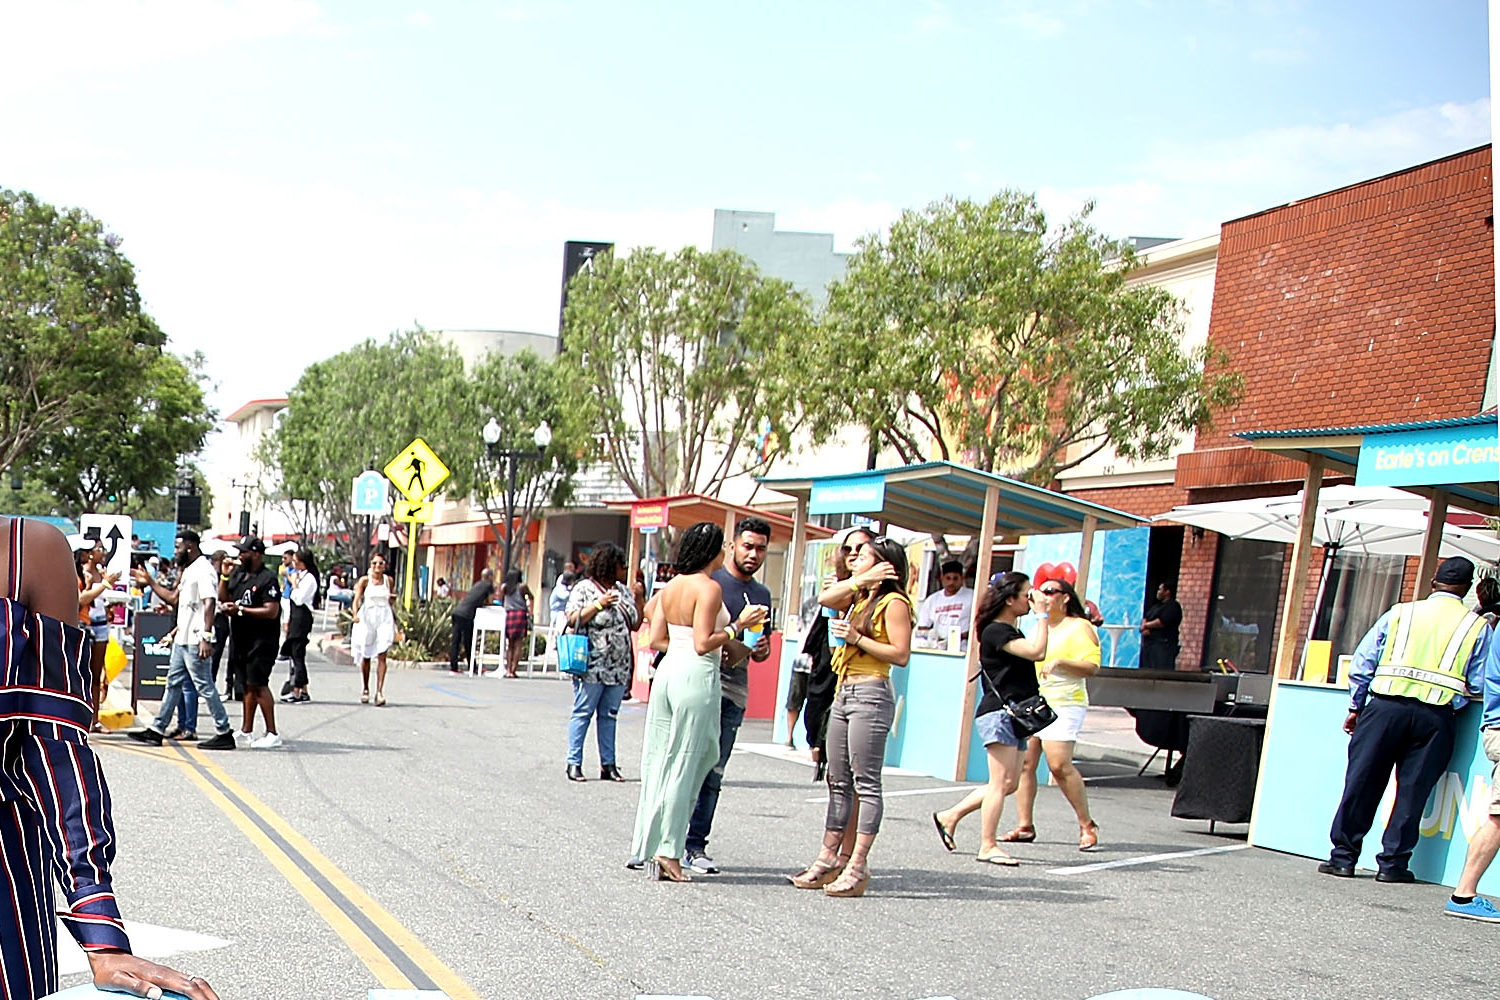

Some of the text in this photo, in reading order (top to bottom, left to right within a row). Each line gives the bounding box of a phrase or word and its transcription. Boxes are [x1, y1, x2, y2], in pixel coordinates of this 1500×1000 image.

[1375, 447, 1425, 471] Earle's
[1427, 449, 1449, 467] on
[364, 487, 378, 506] P
